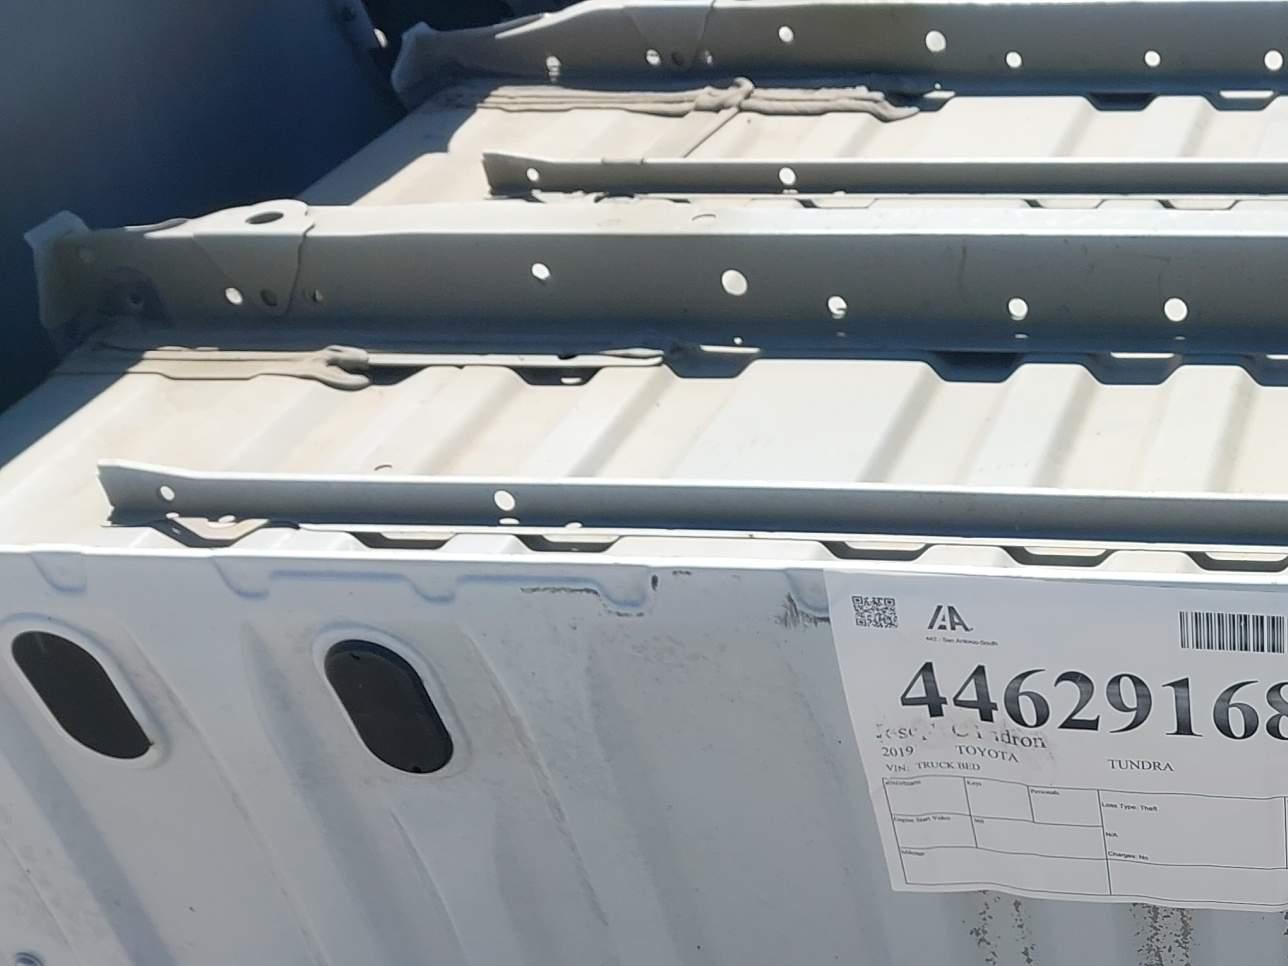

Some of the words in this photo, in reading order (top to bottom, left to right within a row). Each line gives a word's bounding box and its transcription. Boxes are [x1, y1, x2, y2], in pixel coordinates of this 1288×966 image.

[881, 745, 914, 758] 2019
[955, 745, 1020, 764] TOYOTA
[1107, 759, 1175, 772] TUNDRA
[917, 761, 955, 770] TRUCK
[958, 761, 981, 771] BED
